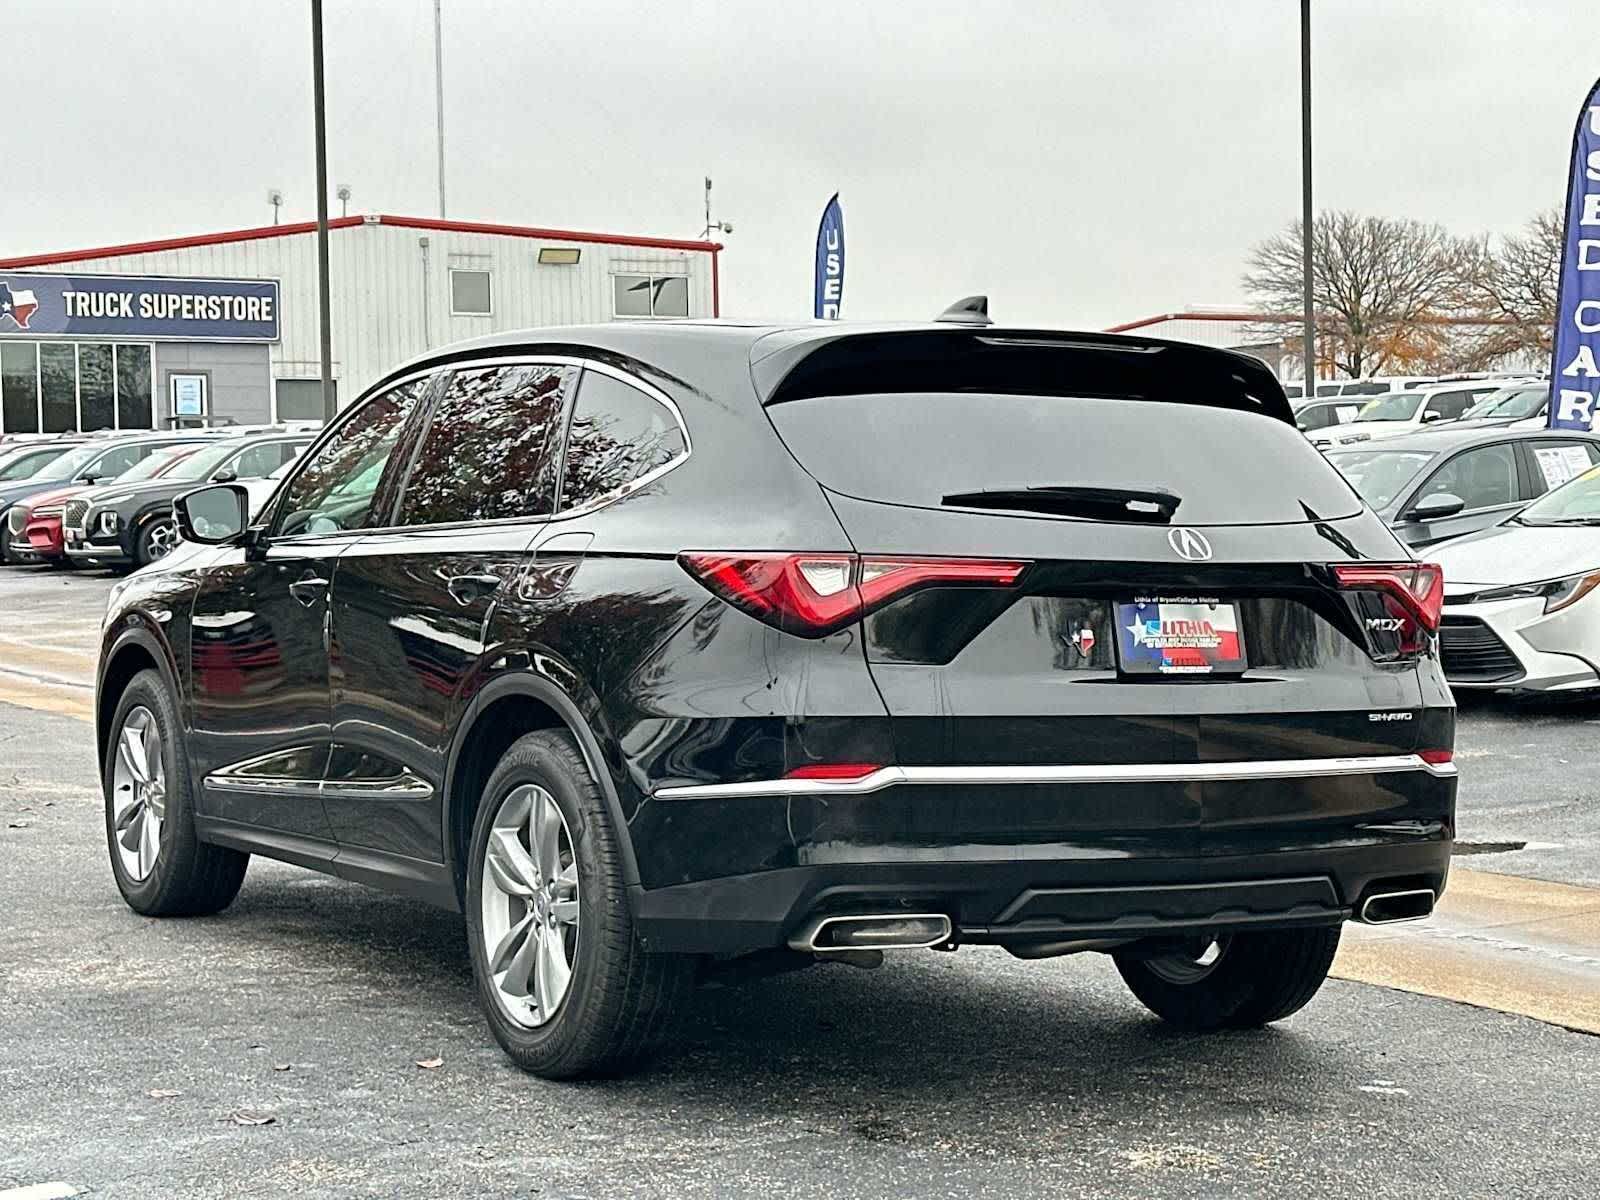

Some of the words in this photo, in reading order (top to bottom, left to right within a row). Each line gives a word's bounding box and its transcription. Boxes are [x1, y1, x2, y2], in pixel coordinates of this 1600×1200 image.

[823, 229, 840, 319] USED
[62, 291, 134, 318] TRUCK
[139, 293, 273, 321] SUPERSTORE
[1162, 620, 1217, 637] LITHIA
[1365, 618, 1406, 631] MDX
